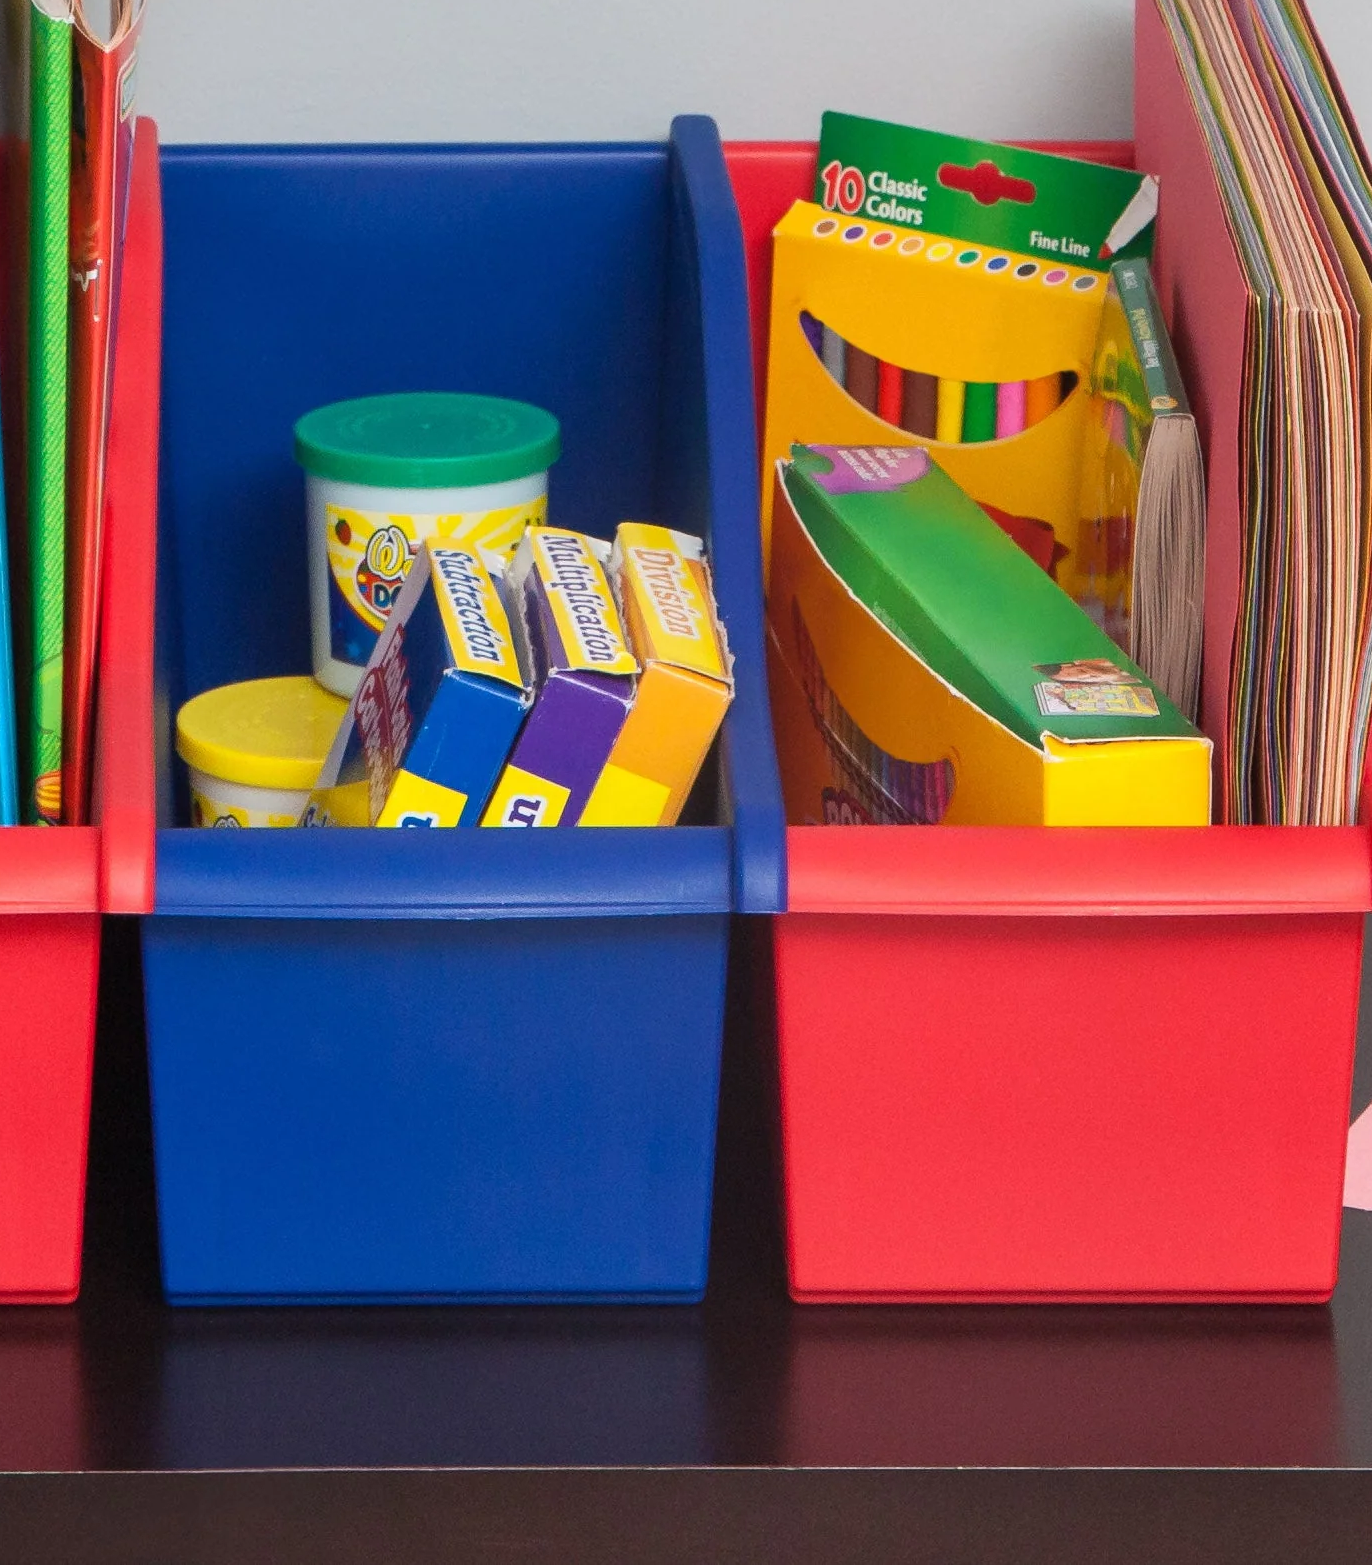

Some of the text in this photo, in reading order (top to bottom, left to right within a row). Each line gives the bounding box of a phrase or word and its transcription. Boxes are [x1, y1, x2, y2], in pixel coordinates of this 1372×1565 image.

[821, 160, 928, 215] 10 Classic
[865, 195, 923, 225] Colors
[1029, 230, 1091, 258] Fine Line
[434, 550, 500, 662] Subtraction
[543, 535, 613, 662] Multiplication
[634, 548, 695, 636] Division
